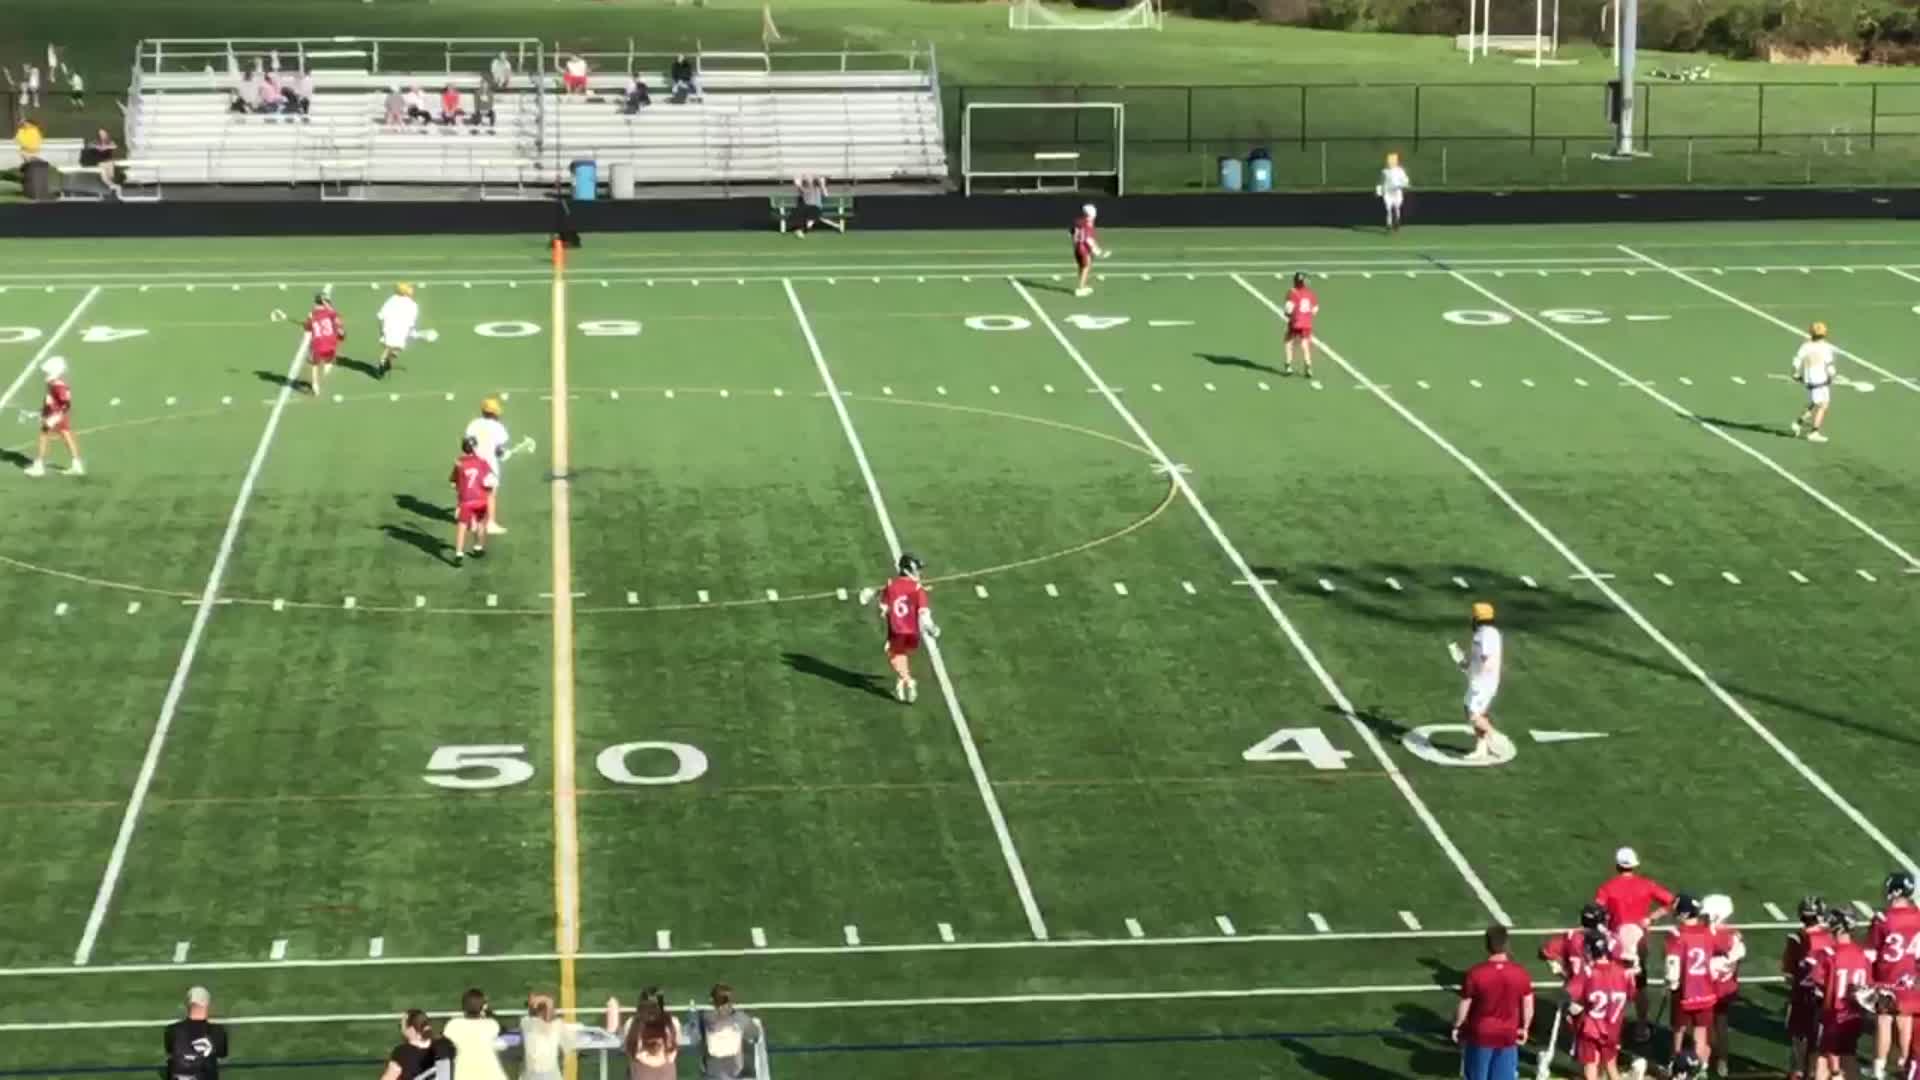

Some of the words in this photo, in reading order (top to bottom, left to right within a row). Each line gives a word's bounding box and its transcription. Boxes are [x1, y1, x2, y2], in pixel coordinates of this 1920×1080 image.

[474, 320, 642, 337] 50
[465, 468, 479, 488] 7
[893, 595, 909, 618] 6
[1242, 723, 1517, 769] 40
[422, 741, 708, 788] 50
[1688, 947, 1706, 975] 2
[1883, 931, 1920, 962] 34
[1588, 990, 1627, 1024] 27
